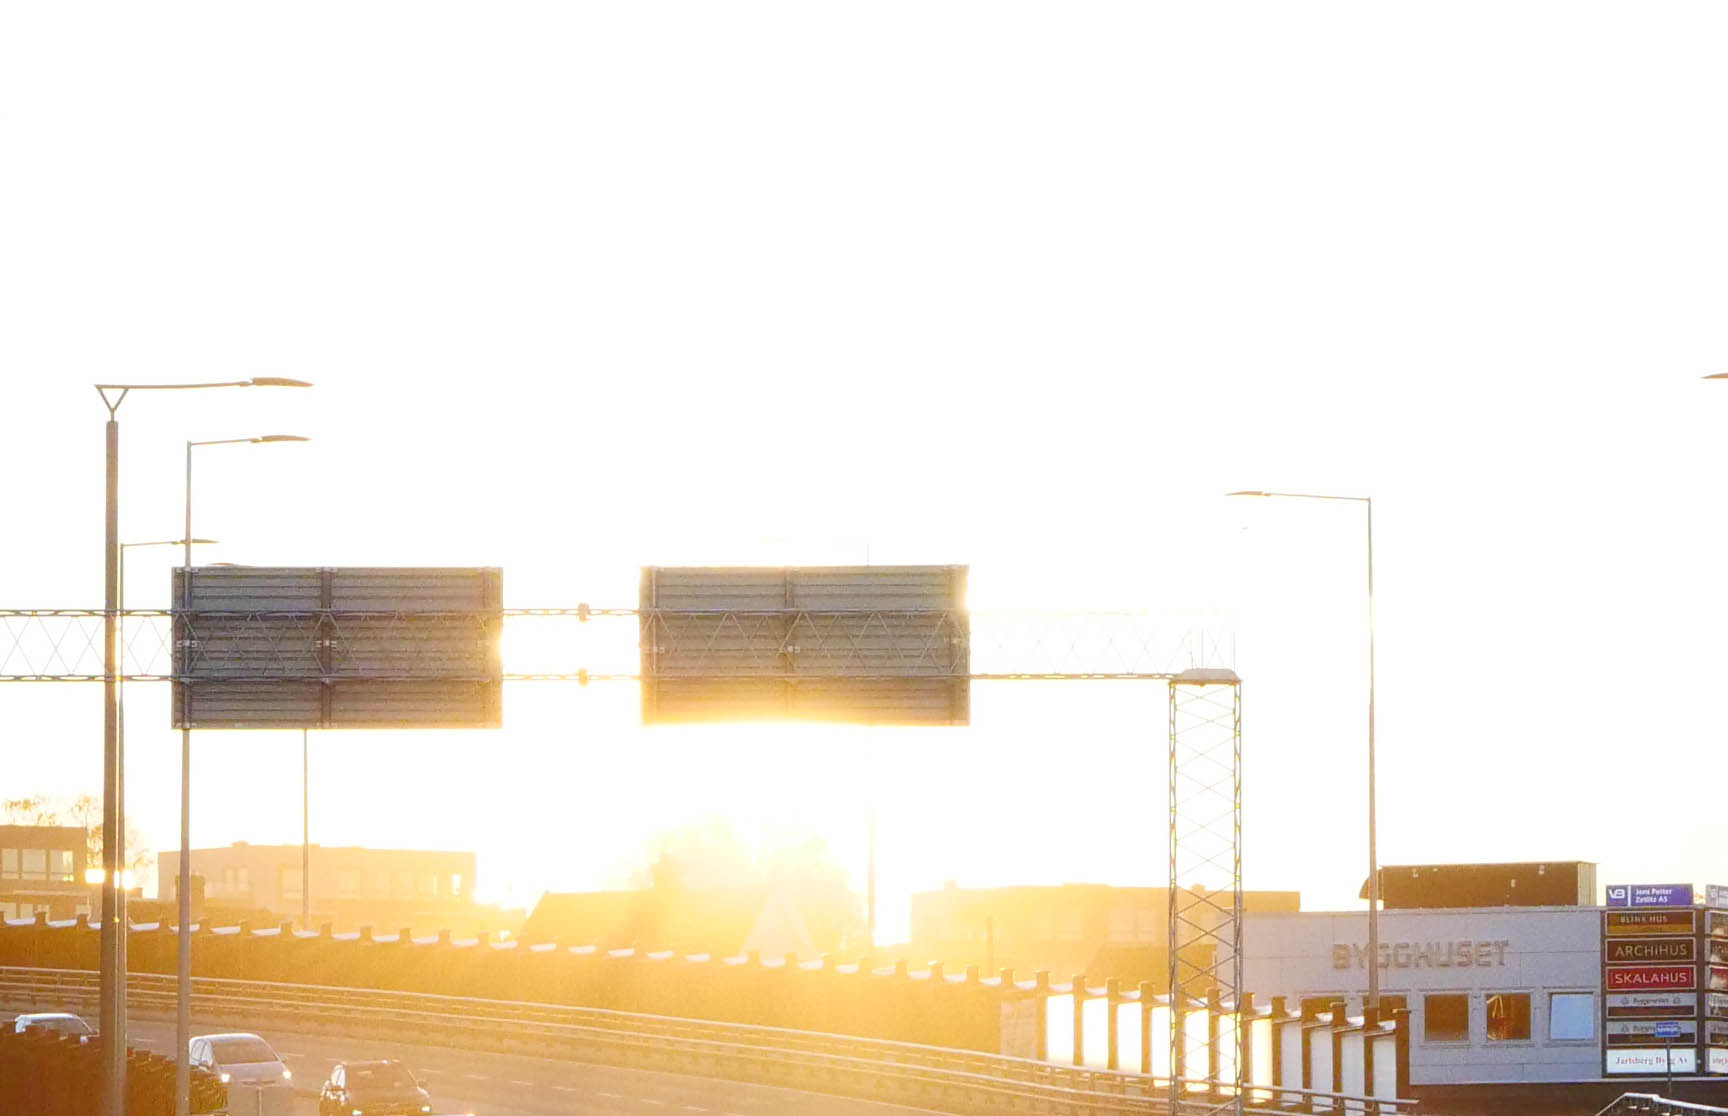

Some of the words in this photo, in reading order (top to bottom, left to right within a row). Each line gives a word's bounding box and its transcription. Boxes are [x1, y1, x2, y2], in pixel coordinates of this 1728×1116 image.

[1658, 895, 1668, 903] AS
[1649, 915, 1669, 924] HUS
[1332, 939, 1509, 970] BYGGHUSET
[1615, 972, 1688, 985] SKALAHUS
